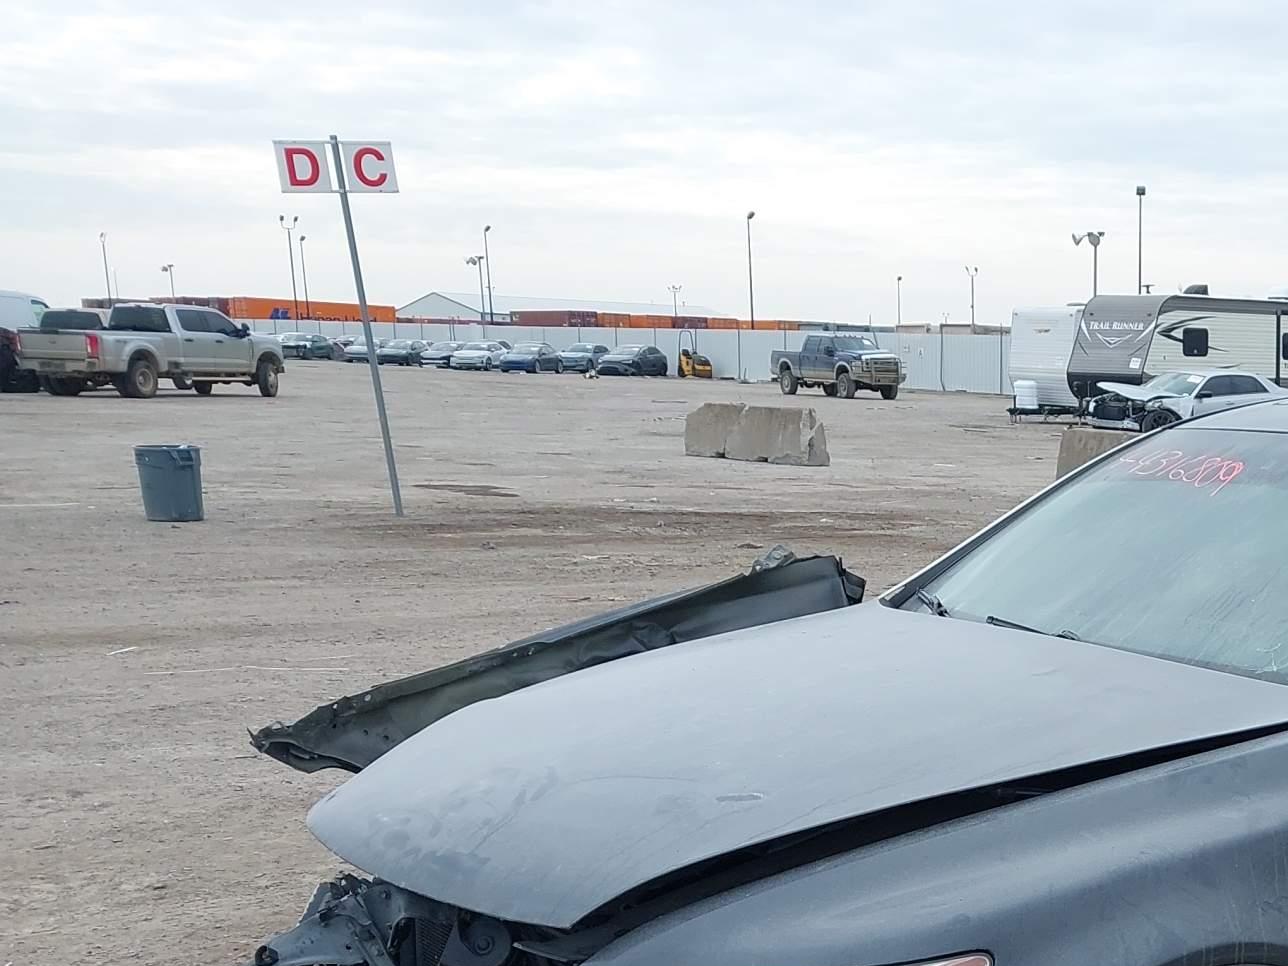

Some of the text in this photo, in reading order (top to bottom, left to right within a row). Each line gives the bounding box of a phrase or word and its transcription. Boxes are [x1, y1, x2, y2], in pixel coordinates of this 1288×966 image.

[284, 147, 320, 187] D
[353, 147, 388, 187] C
[1088, 320, 1144, 331] TRAIL RUNNER
